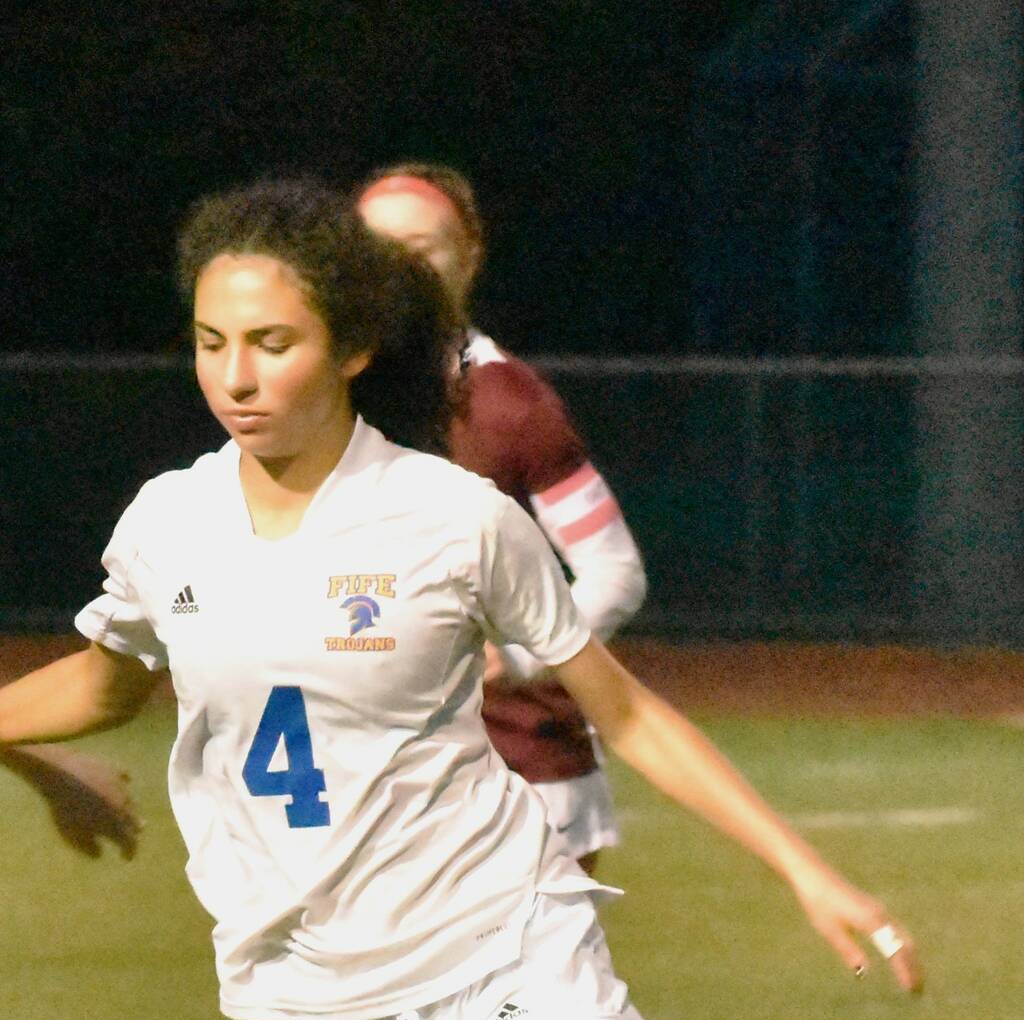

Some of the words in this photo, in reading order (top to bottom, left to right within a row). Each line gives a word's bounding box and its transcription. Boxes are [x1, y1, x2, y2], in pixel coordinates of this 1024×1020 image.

[327, 574, 397, 599] FIFE
[171, 602, 199, 614] adidas
[324, 636, 396, 651] TROJANS
[242, 685, 331, 829] 4
